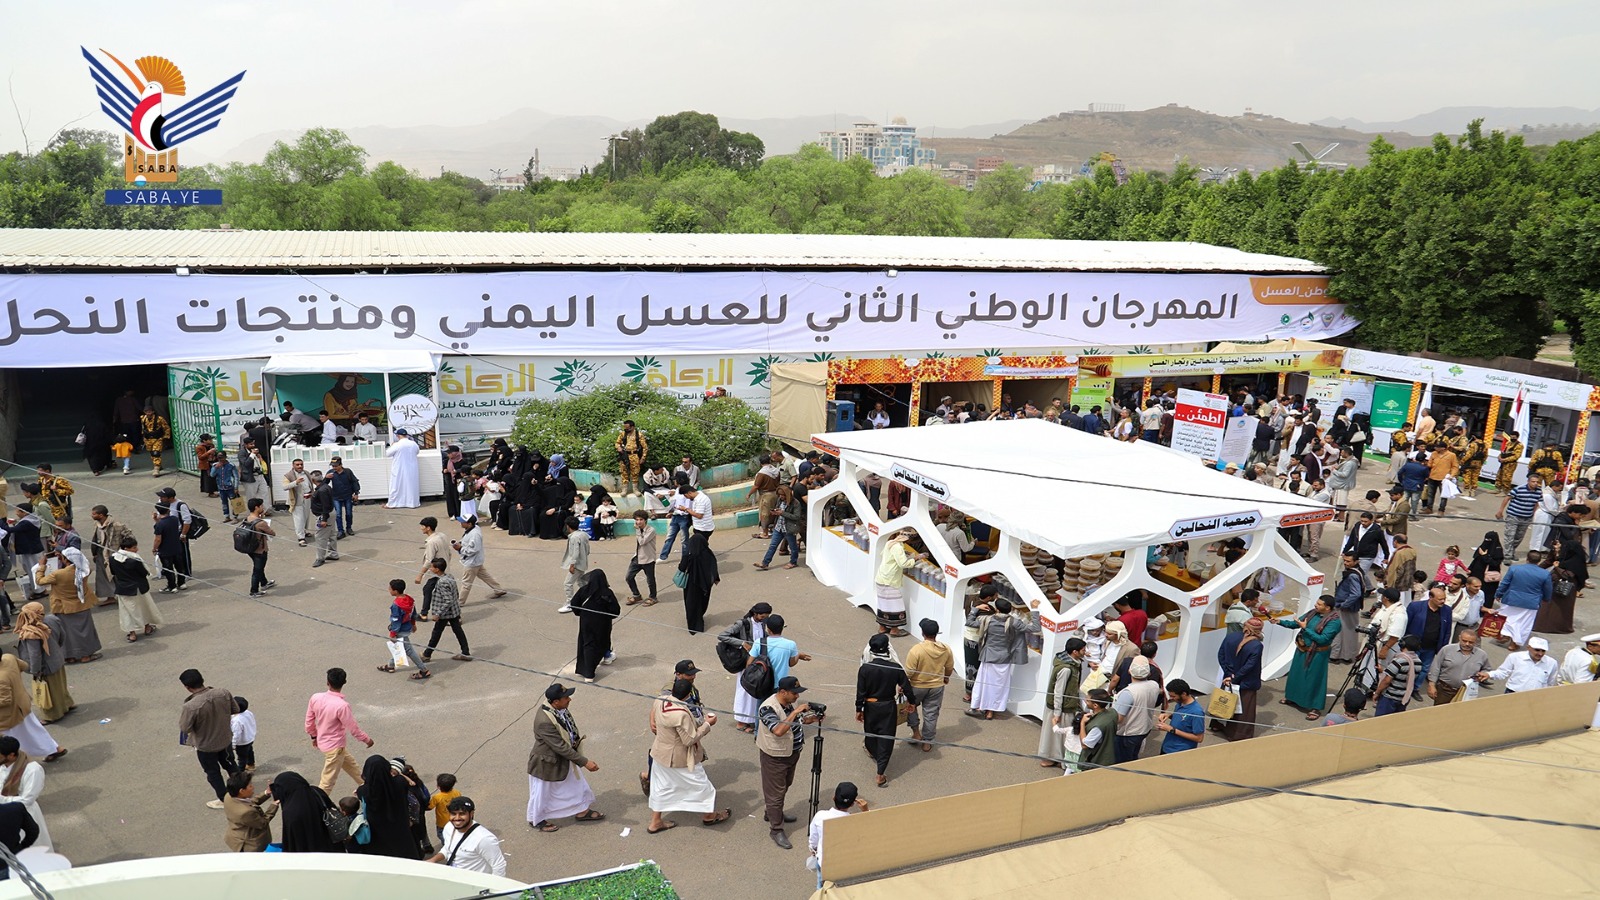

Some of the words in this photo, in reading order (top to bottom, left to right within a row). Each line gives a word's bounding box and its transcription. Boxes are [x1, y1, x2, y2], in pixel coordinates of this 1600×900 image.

[0, 296, 150, 347] النحل
[176, 293, 416, 343] ومنتجات
[438, 293, 595, 349] اليمني
[616, 294, 788, 336] للعسل
[805, 286, 918, 343] الثاني
[935, 290, 1068, 340] الوطني
[1082, 292, 1238, 330] المهرجان
[647, 358, 734, 390] الزكاة
[1149, 359, 1169, 367] العسل
[1219, 356, 1241, 365] اليمنية
[440, 363, 536, 397] الزكاة
[1524, 380, 1548, 390] مؤسسة
[459, 399, 496, 409] العامة
[893, 467, 920, 485] النحالين
[921, 477, 946, 498] جمعية
[1174, 518, 1221, 537] النحالين
[1222, 515, 1257, 530] جمعية
